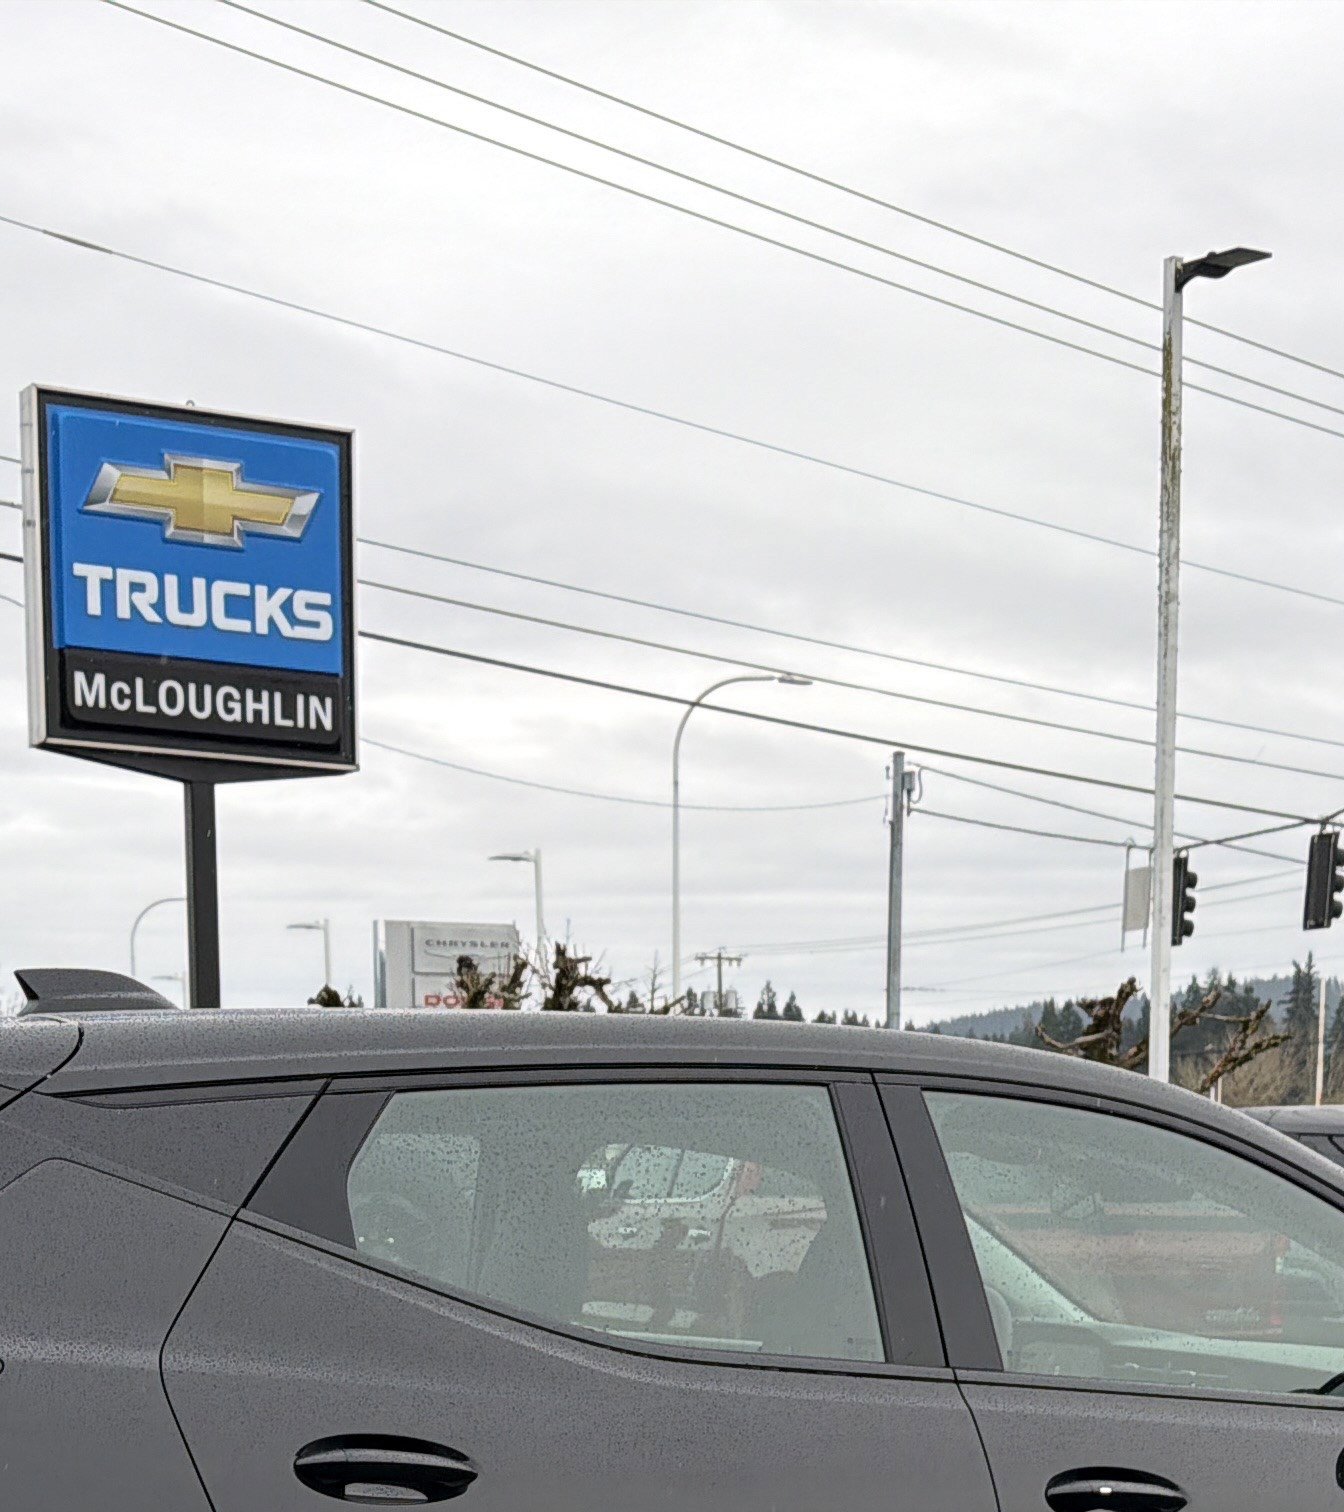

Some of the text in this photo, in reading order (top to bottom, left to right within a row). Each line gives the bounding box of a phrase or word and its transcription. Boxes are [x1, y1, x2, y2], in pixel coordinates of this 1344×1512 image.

[73, 562, 333, 641] TRUCKS
[73, 671, 333, 731] McLOUGHLIN
[424, 938, 510, 949] CHRYSLER
